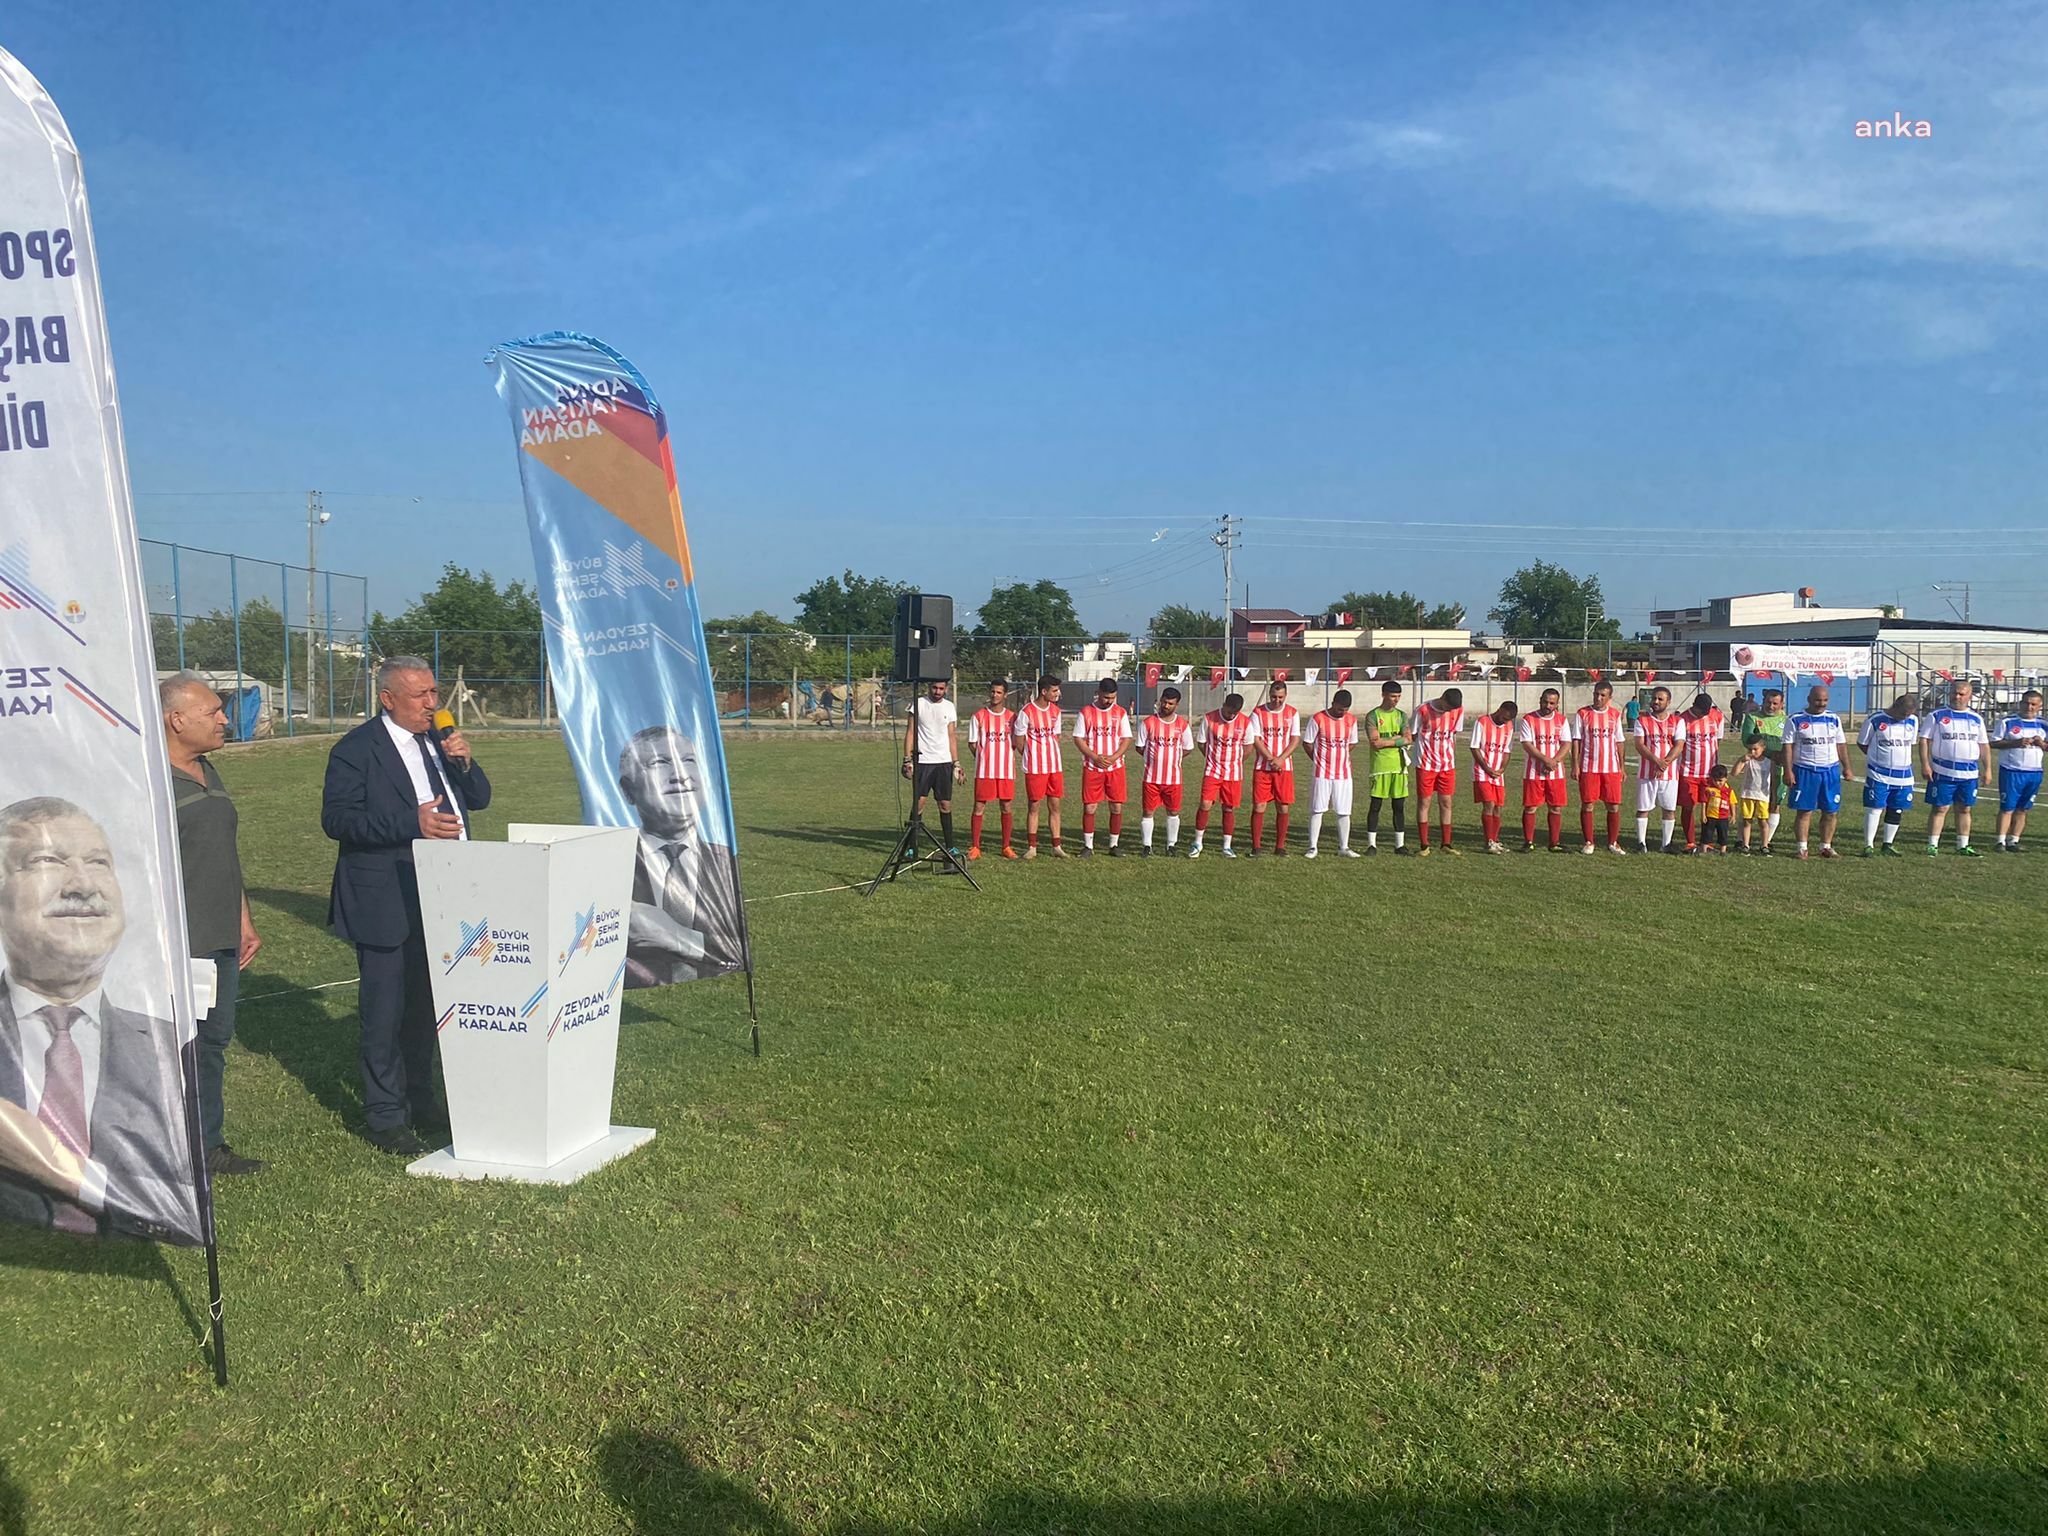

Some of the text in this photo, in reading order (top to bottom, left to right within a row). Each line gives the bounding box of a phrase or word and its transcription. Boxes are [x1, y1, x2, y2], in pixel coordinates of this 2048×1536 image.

[1761, 661, 1796, 669] FUTBOL
[1794, 789, 1802, 802] 7
[595, 908, 620, 923] BÜYÜK
[492, 929, 529, 941] BÜYÜK
[598, 921, 619, 937] ŞEHİR
[497, 942, 530, 955] ŞEHİR
[593, 936, 619, 949] ADANA
[493, 955, 531, 964] ADANA
[458, 1003, 516, 1017] ZEYDAN
[564, 991, 605, 1016] ZEYDAN
[563, 1004, 610, 1032] KARALAR
[458, 1018, 528, 1033] KARALAR
